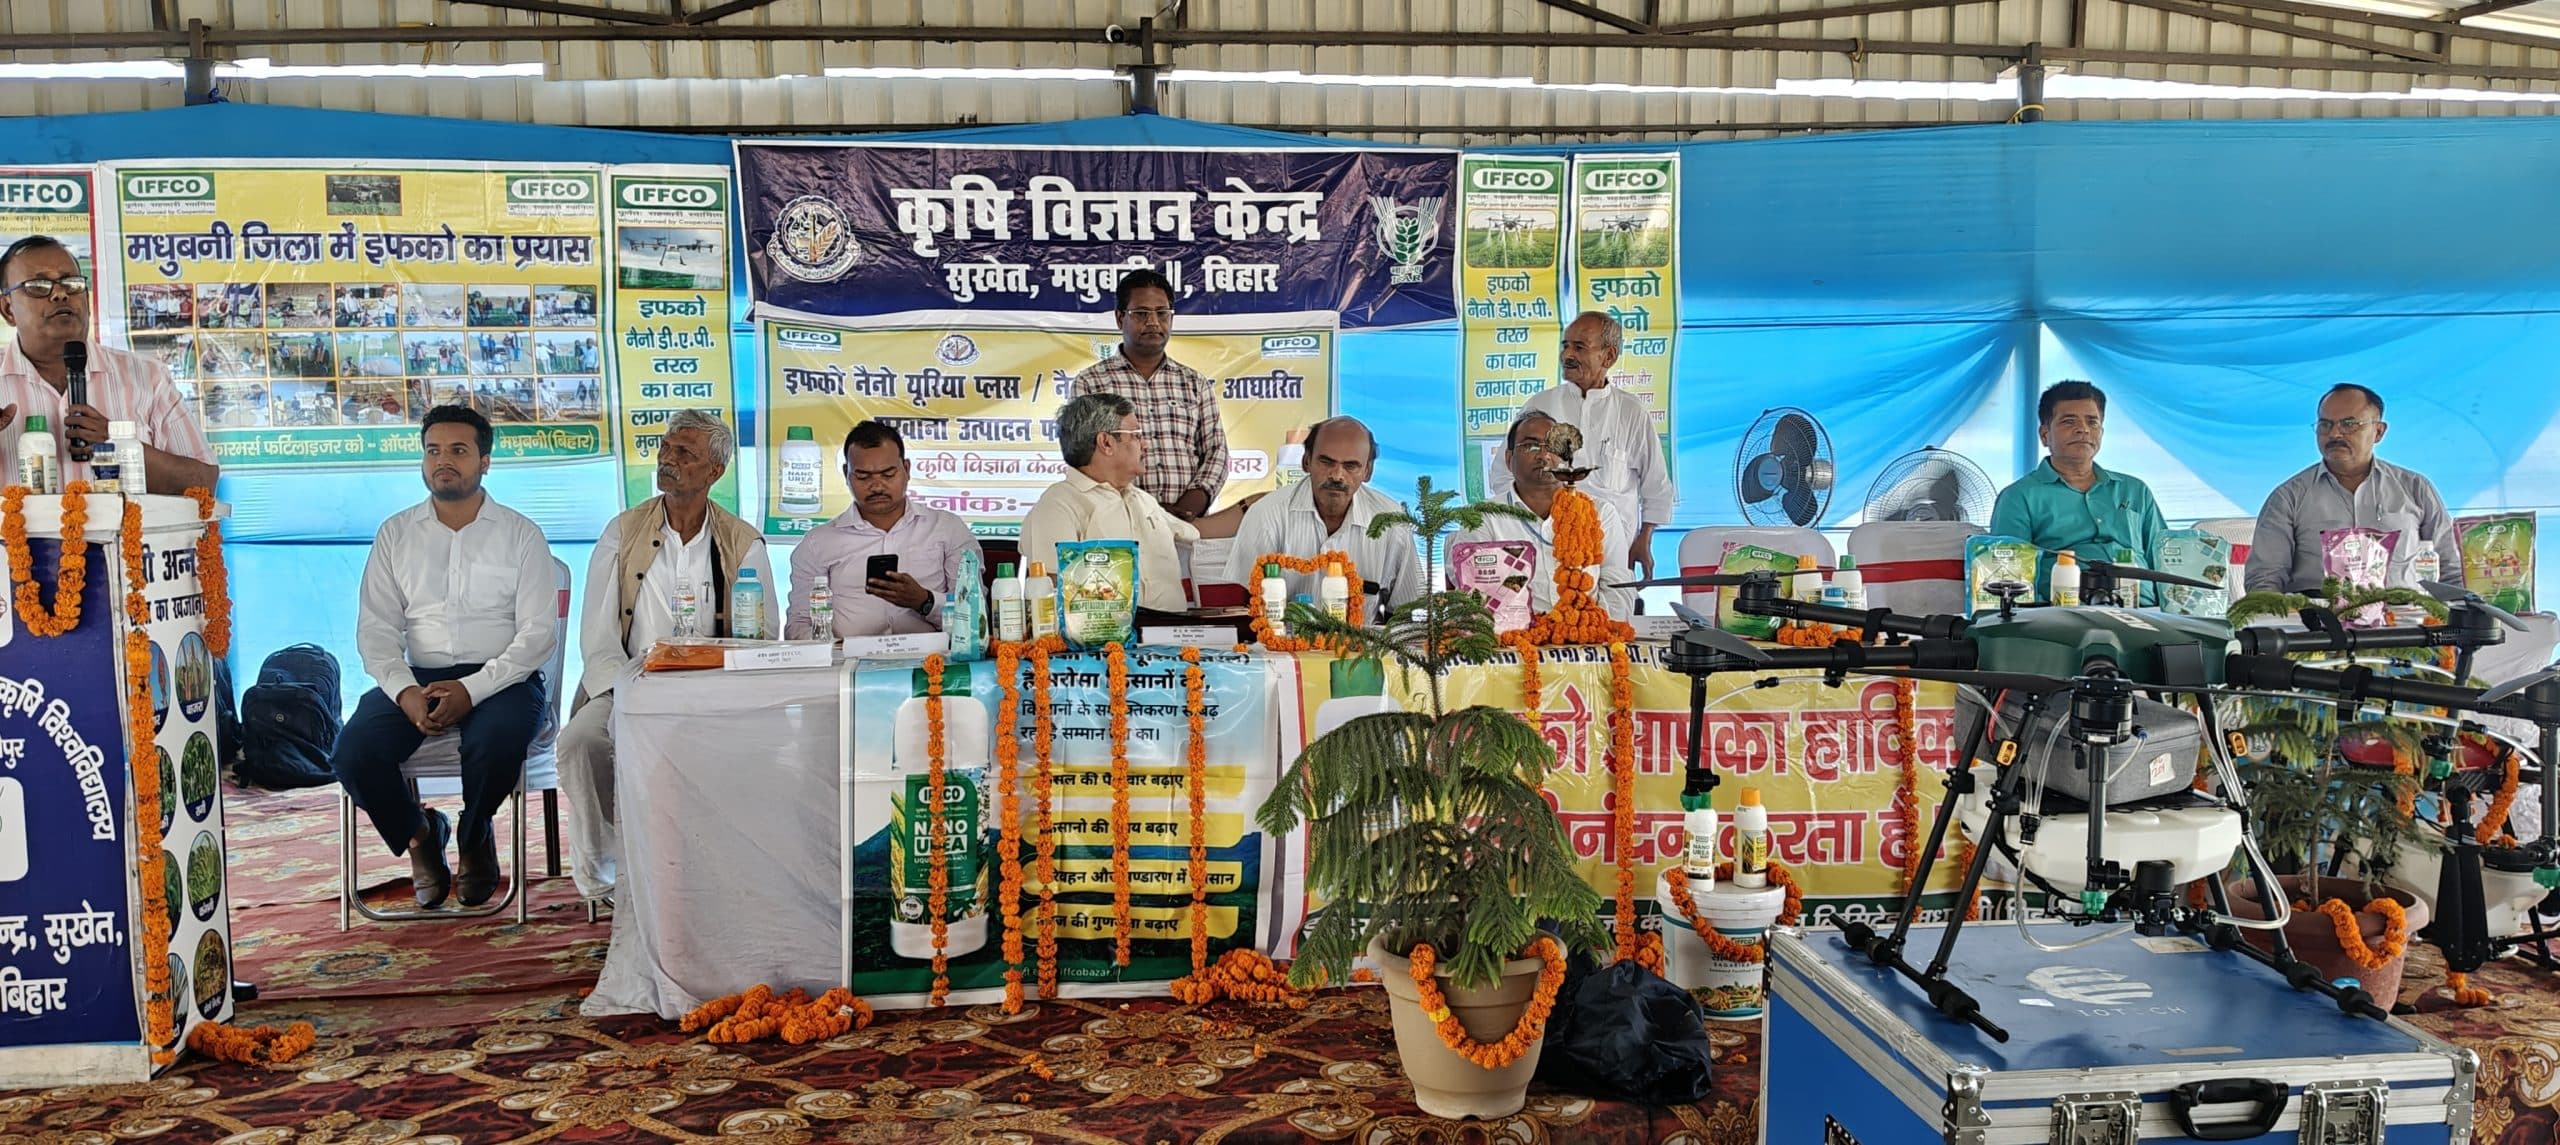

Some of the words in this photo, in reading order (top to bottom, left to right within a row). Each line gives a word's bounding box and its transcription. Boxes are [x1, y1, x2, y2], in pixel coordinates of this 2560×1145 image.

[137, 179, 201, 194] IFFCO
[1482, 171, 1546, 186] IFFCO
[1595, 172, 1658, 187] IFFCO
[0, 183, 73, 203] IFFCO
[520, 183, 581, 196] IFFCO
[634, 187, 708, 203] IFFCO
[890, 174, 1014, 258] कृषि
[1025, 175, 1197, 243] विज्ञान
[1208, 176, 1324, 244] केन्द्र
[126, 220, 233, 278] मधुबनी
[240, 221, 321, 261] जिला
[328, 222, 355, 261] में
[364, 224, 456, 266] इफको
[462, 234, 504, 262] का
[512, 234, 593, 270] प्रयास
[943, 255, 1040, 303] सुखेत,
[1201, 255, 1280, 293] बिहार
[1487, 271, 1530, 295] इफको
[1590, 270, 1661, 301] इफको
[638, 295, 705, 318] इफको
[1467, 297, 1496, 319] नैनो
[1497, 298, 1552, 319] डी.ए.पी.
[626, 326, 656, 350] नैनो
[657, 326, 715, 352] डी.ए.पी.
[786, 330, 831, 342] IFFCO
[1271, 337, 1311, 348] IFFCO
[1496, 326, 1529, 344] तरल
[653, 357, 699, 375] तरल
[1485, 353, 1504, 370] का
[1507, 352, 1536, 369] वादा
[641, 383, 671, 400] का
[672, 382, 713, 399] वादा
[783, 364, 846, 396] इफको
[853, 364, 897, 398] नैनो
[905, 368, 966, 407] यूरिया
[974, 374, 1020, 400] प्लस
[1222, 368, 1304, 400] आधारित
[1475, 380, 1516, 398] लागत
[630, 408, 669, 428] लाग
[957, 416, 1031, 442] उत्पादन
[264, 435, 342, 456] फर्टिलाइजर
[346, 436, 364, 454] को
[916, 453, 956, 479] कृषि
[963, 453, 1020, 474] विज्ञान
[1026, 453, 1069, 477] केन्द्र
[1062, 728, 1105, 741] सम्मान
[1081, 771, 1098, 785] की
[1151, 773, 1184, 788] बढ़ाए
[1091, 818, 1109, 834] की
[1146, 821, 1178, 837] बढ़ाए
[43, 899, 123, 965] सुखेत,
[1071, 912, 1088, 928] की
[1145, 917, 1179, 932] बढ़ाए
[0, 966, 68, 1015] बिहार
